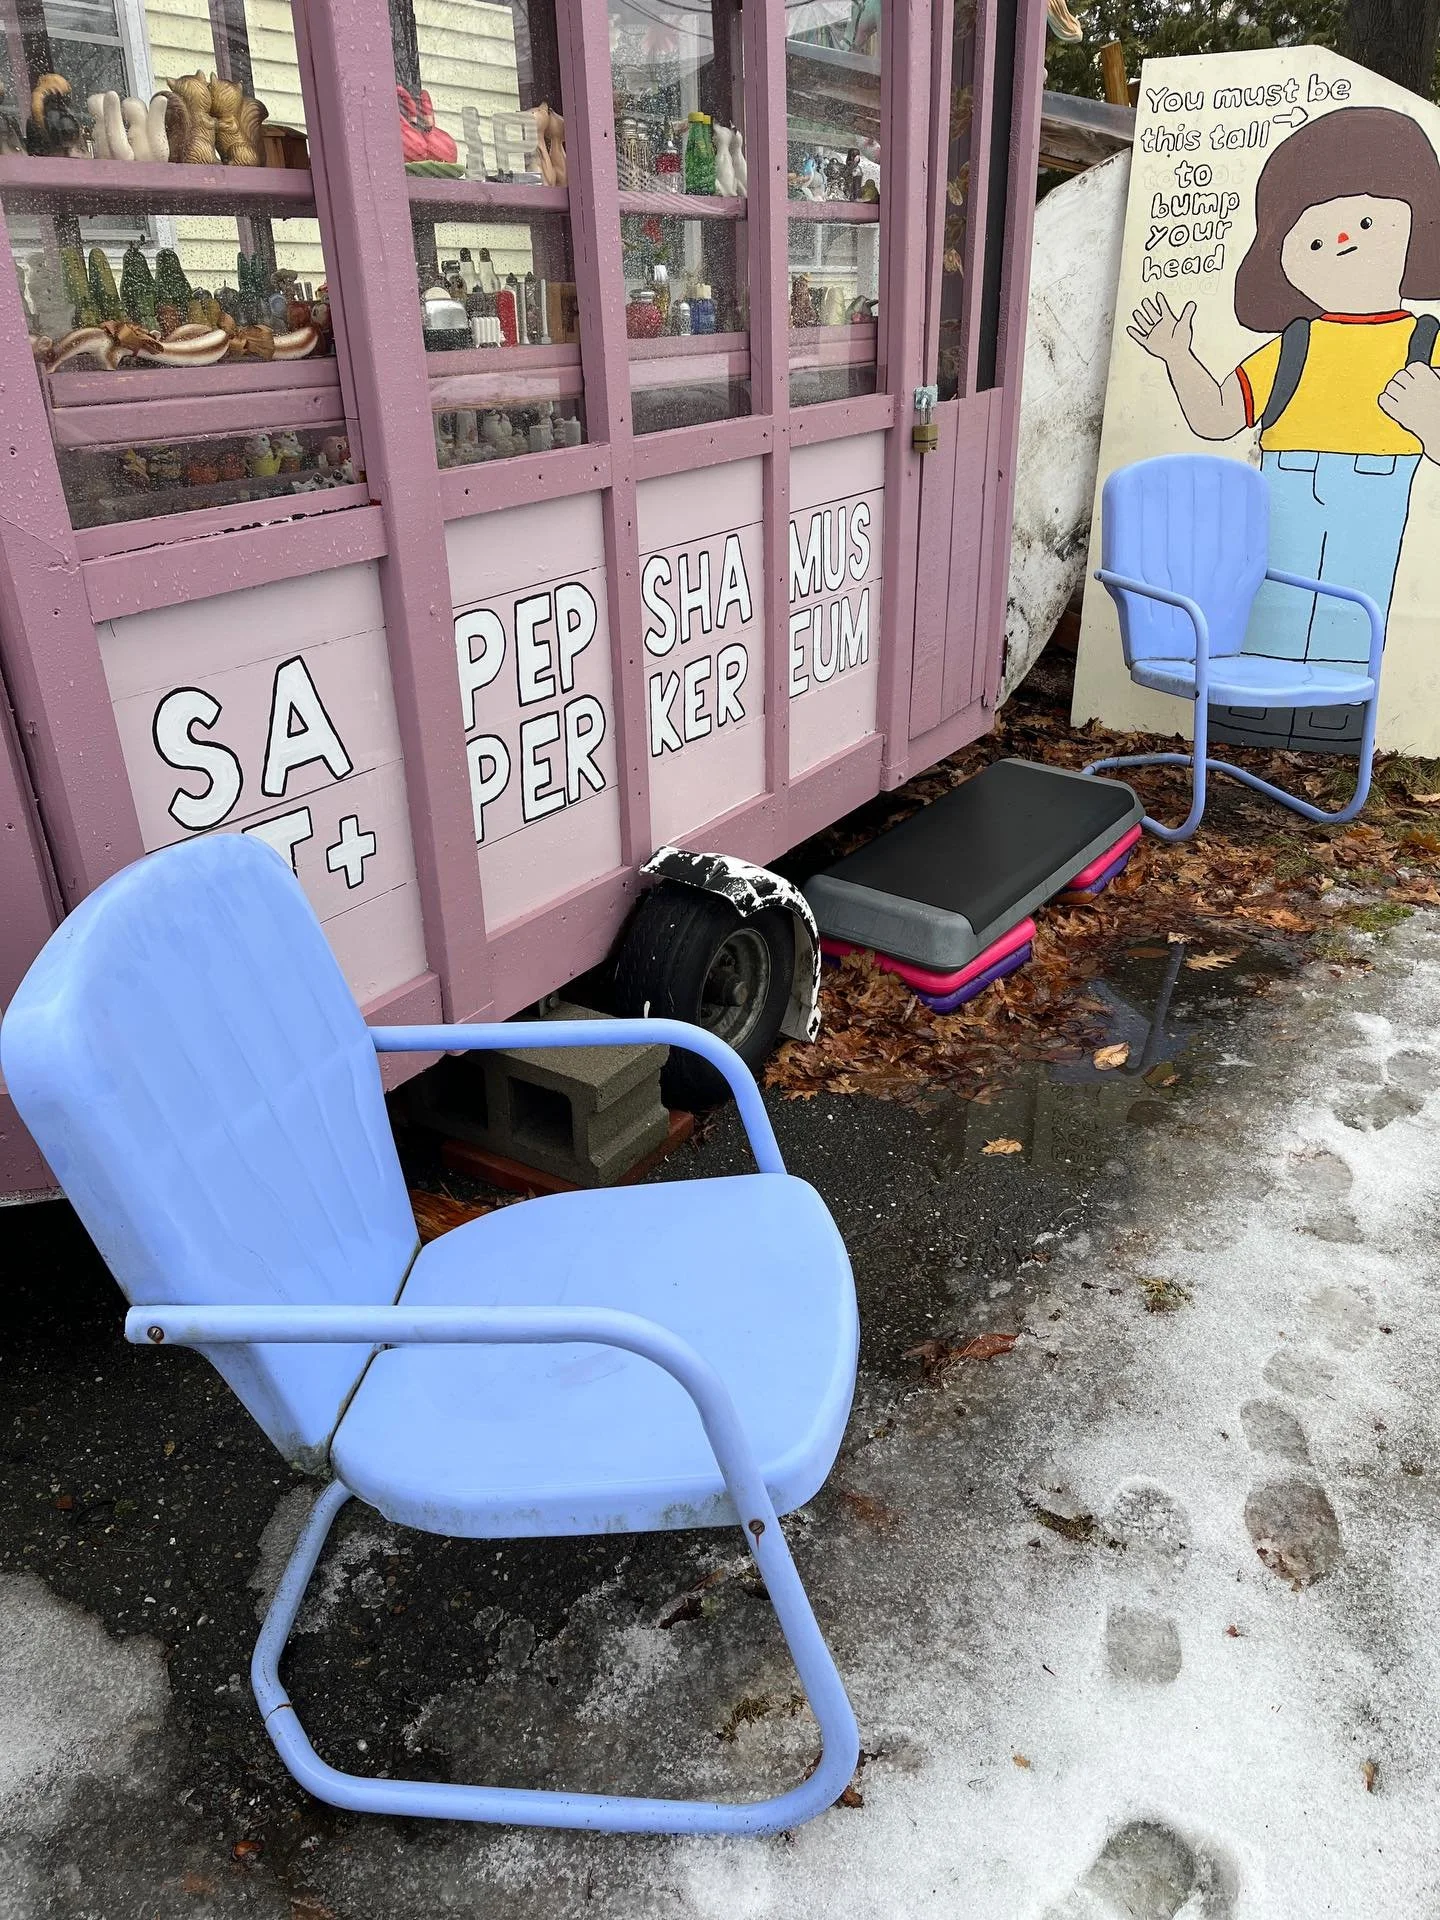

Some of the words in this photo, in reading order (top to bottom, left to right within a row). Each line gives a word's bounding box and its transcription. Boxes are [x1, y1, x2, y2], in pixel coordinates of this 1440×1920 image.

[1140, 123, 1202, 152] this
[1209, 120, 1270, 150] tall
[1146, 87, 1204, 113] You
[1213, 78, 1300, 109] must
[1307, 73, 1352, 102] be
[1151, 191, 1240, 219] bump
[1174, 159, 1213, 189] to
[1142, 244, 1225, 283] head
[1144, 220, 1232, 251] your
[641, 533, 753, 657] SHA
[789, 502, 871, 603] MUS
[453, 582, 598, 732] PEP
[789, 588, 870, 699] EUM
[152, 655, 354, 831] SA
[649, 643, 748, 758] KER
[465, 694, 606, 844] PER
